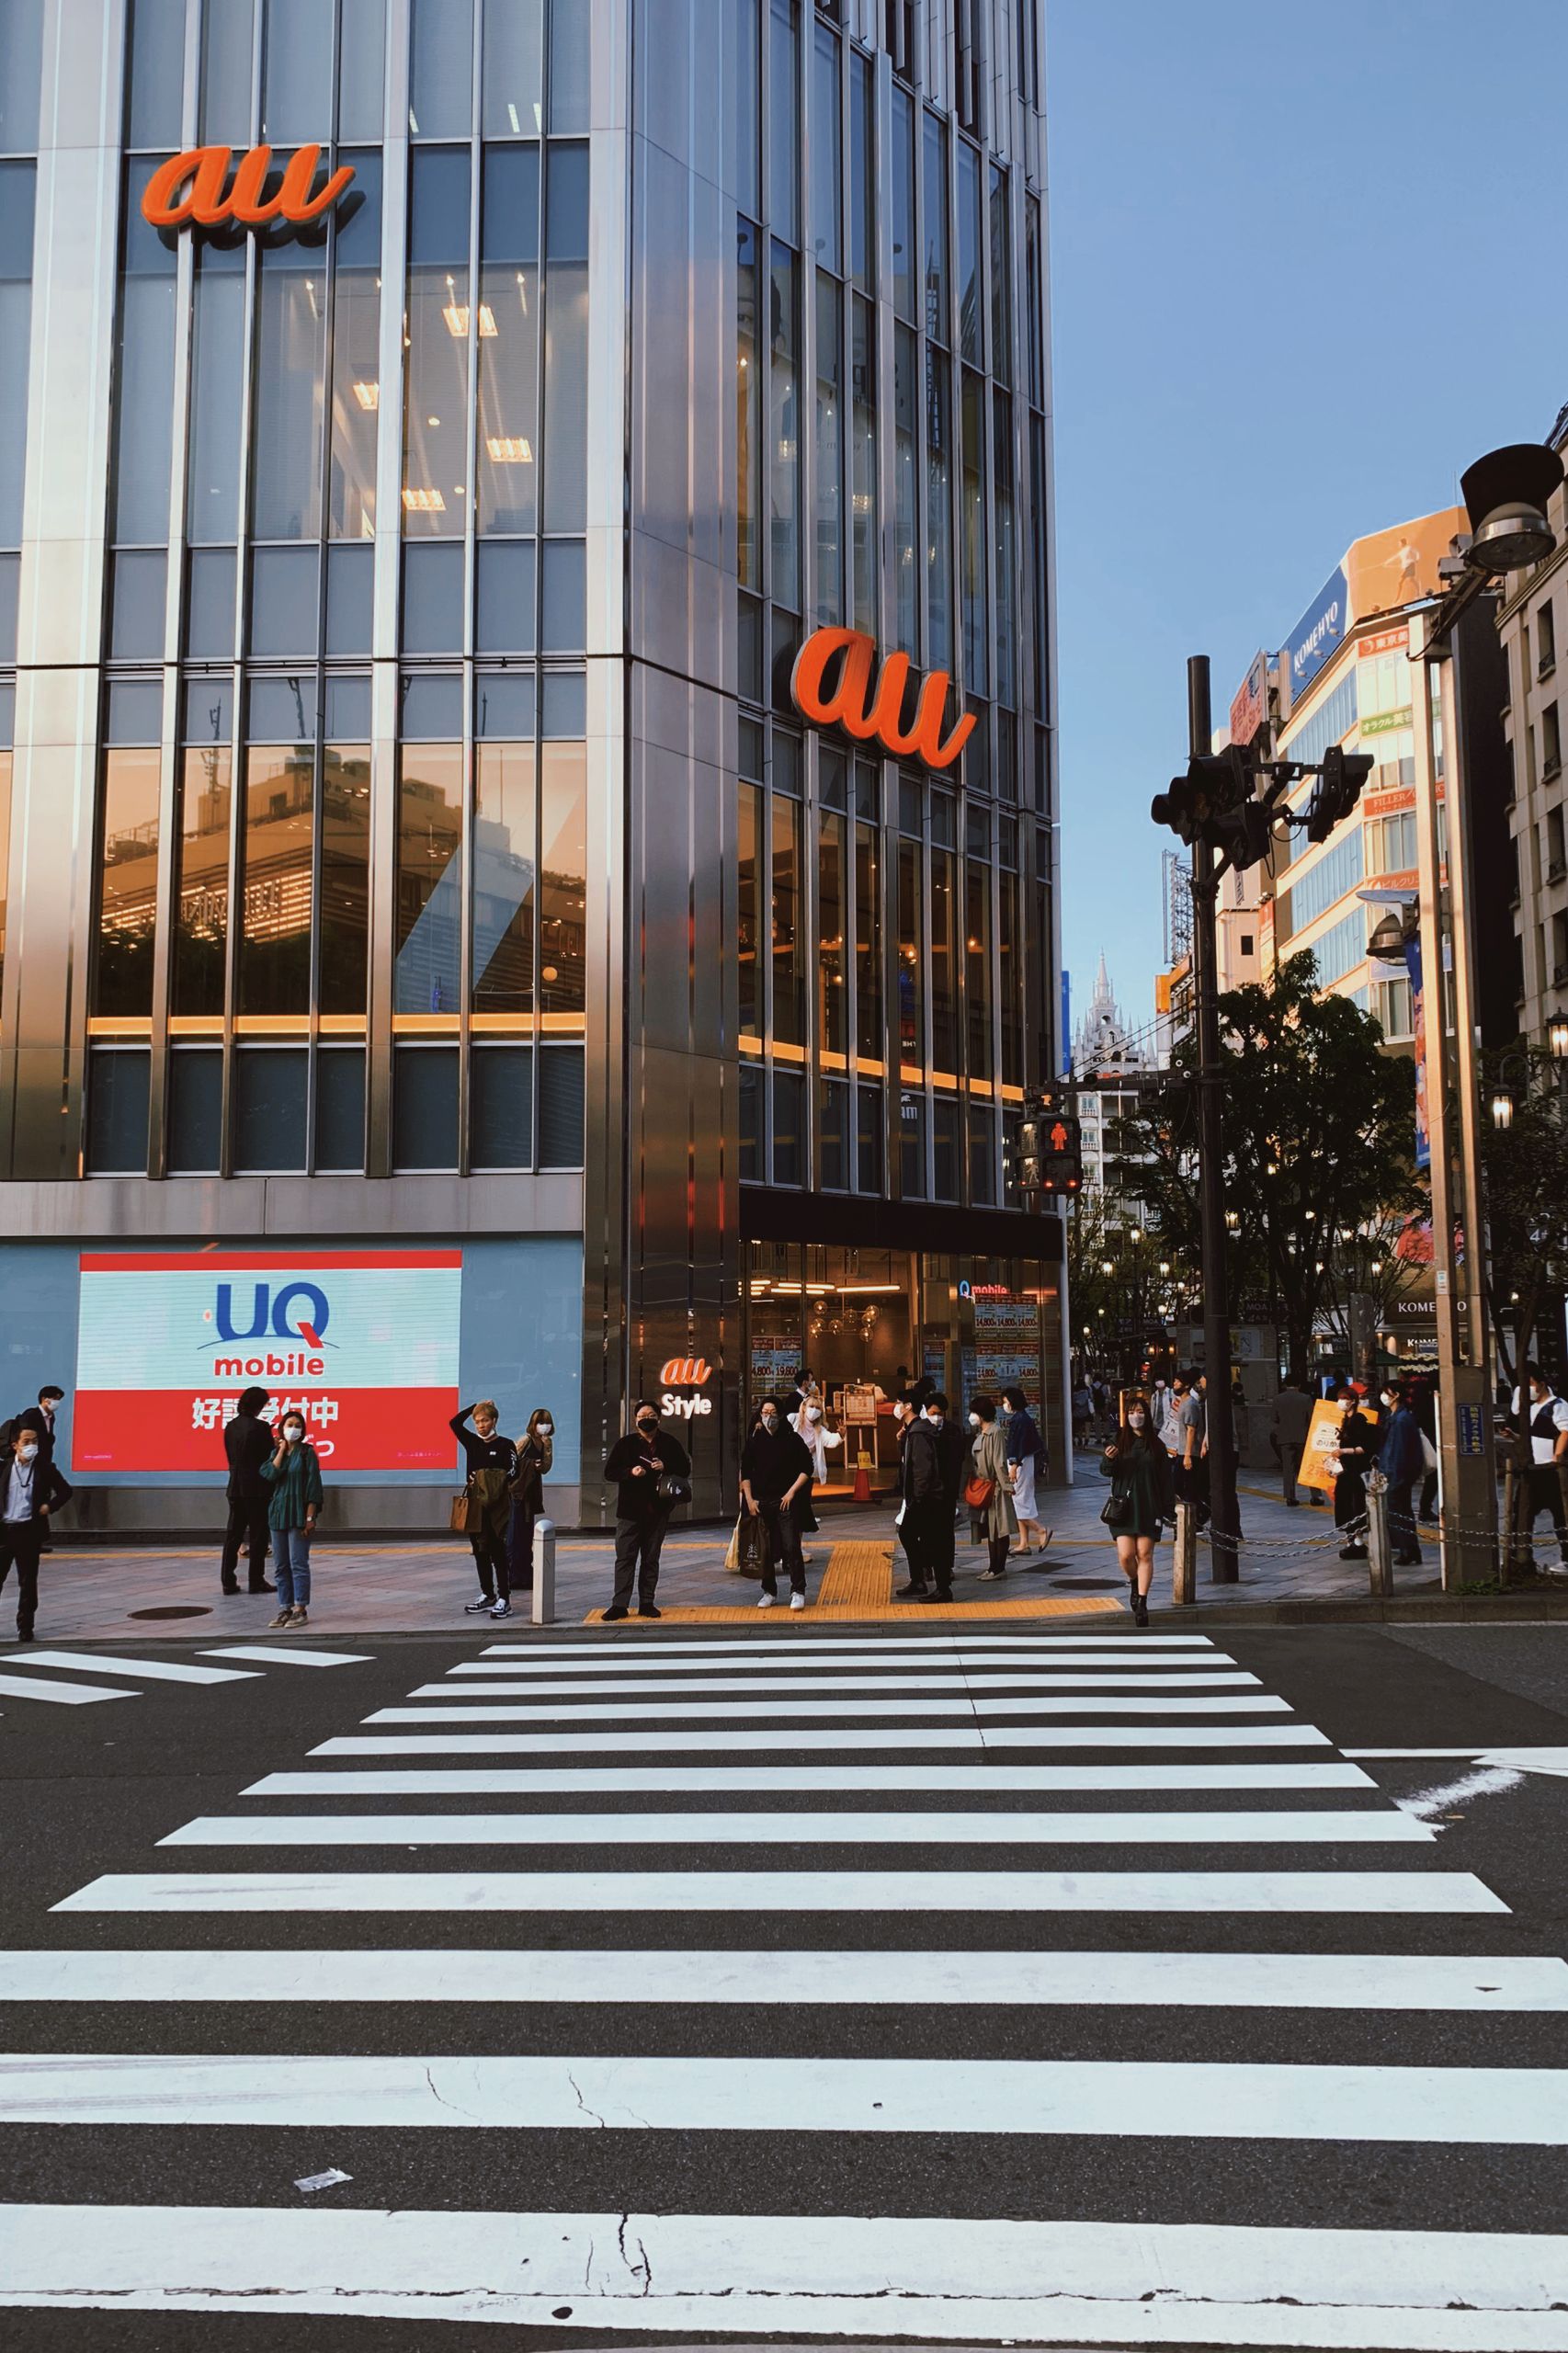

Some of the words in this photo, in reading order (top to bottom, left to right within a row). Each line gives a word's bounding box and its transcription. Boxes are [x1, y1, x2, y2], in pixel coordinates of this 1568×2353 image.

[141, 144, 357, 228] au
[1294, 601, 1337, 673] KOMEHYO
[790, 627, 978, 769] au
[216, 1281, 330, 1348] UQ
[1398, 1302, 1467, 1313] KOMEO
[213, 1353, 325, 1377] mobile
[661, 1357, 712, 1385] au
[661, 1392, 712, 1419] Style
